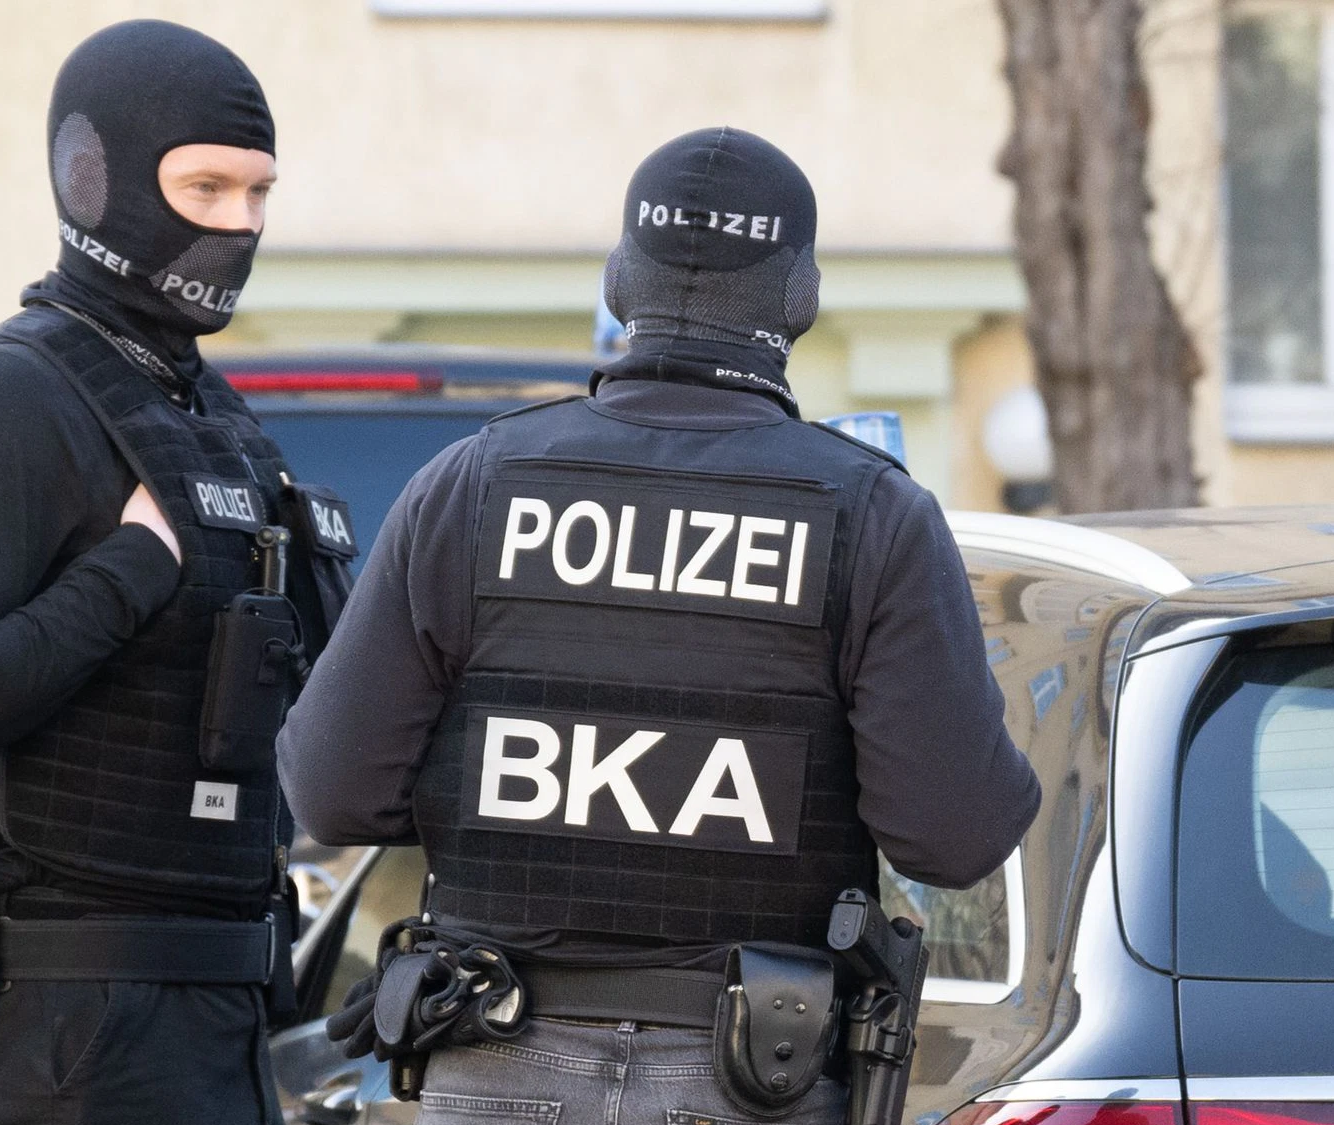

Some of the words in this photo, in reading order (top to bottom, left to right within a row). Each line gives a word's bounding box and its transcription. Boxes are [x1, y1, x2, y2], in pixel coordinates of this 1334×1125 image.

[637, 200, 782, 242] POLIZEI
[195, 482, 257, 523] POLIZEI
[311, 500, 352, 545] BKA
[498, 496, 809, 606] POLIZEI
[478, 716, 774, 843] BKA
[205, 795, 224, 808] BKA
